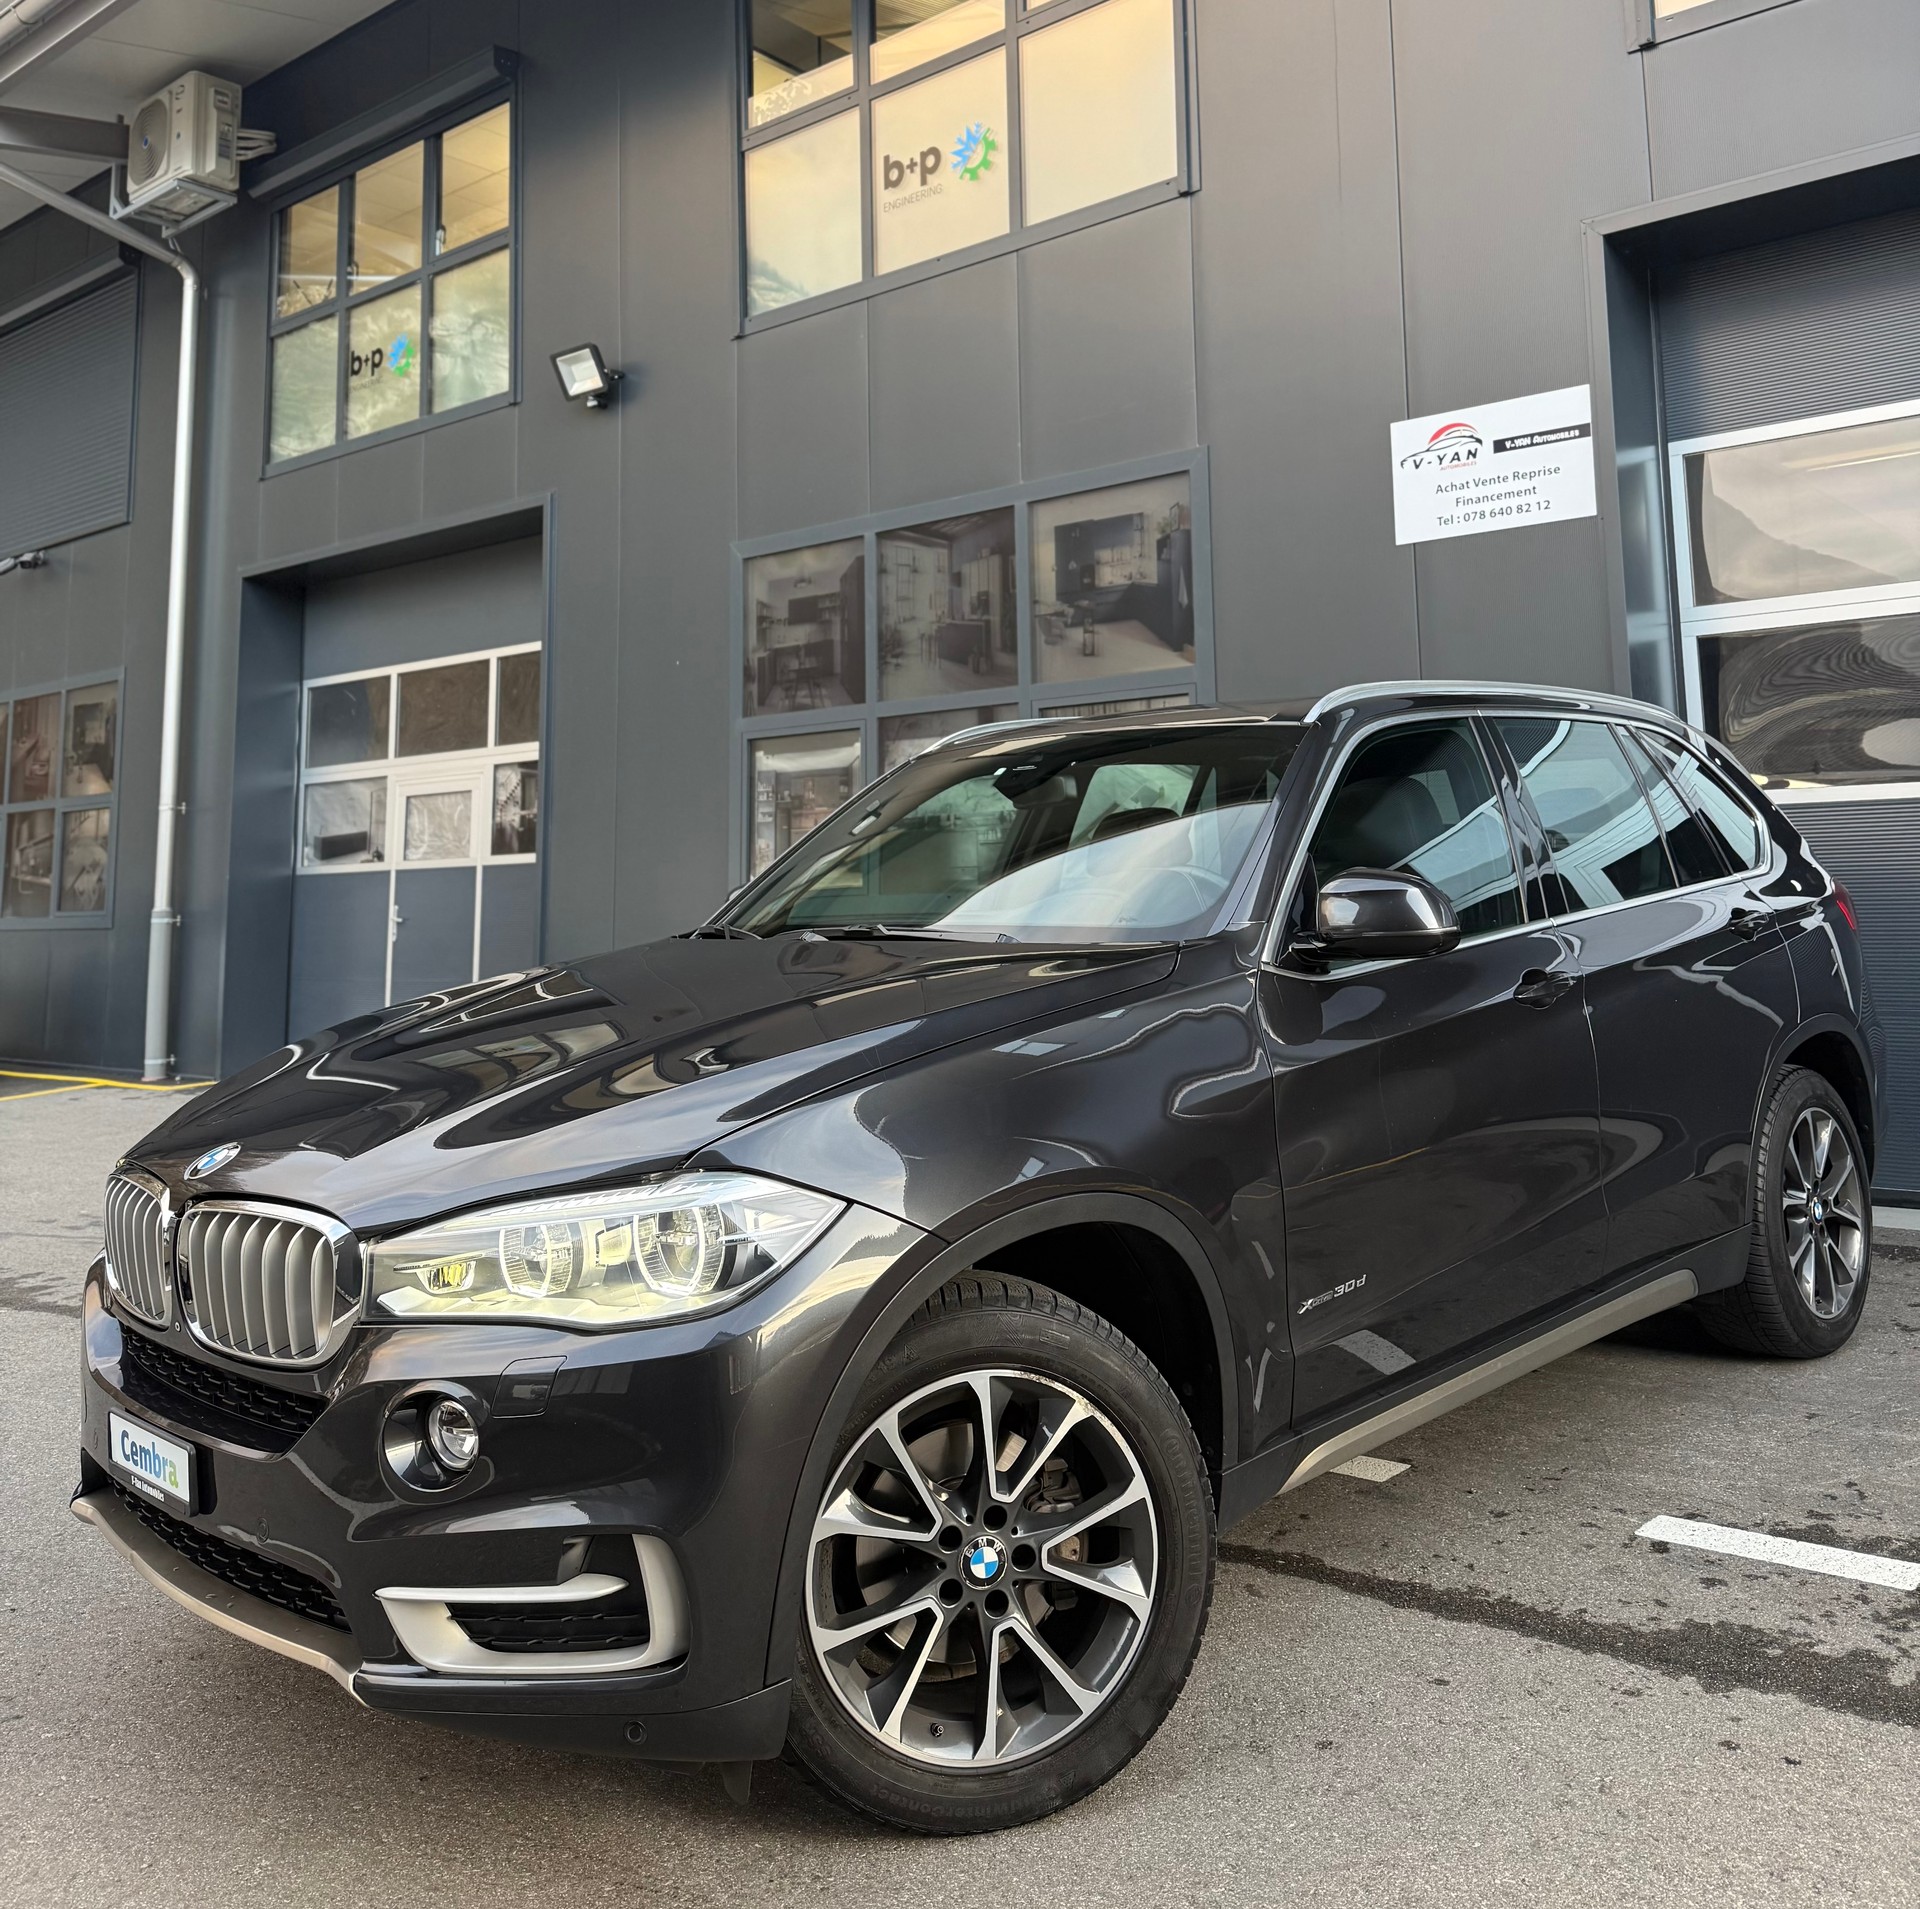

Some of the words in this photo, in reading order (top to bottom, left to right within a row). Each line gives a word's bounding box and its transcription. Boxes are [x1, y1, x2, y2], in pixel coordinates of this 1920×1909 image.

[883, 146, 942, 190] b+p
[883, 184, 943, 213] ENGINEERING
[350, 347, 383, 377] b+p
[1435, 480, 1470, 494] Achat
[1473, 474, 1509, 488] Vente
[1512, 465, 1561, 481] Reprise
[1455, 486, 1537, 507] Financement
[1463, 510, 1486, 522] 078
[1489, 505, 1513, 518] 640
[1516, 503, 1532, 514] 82
[1536, 499, 1551, 511] 12
[121, 1430, 178, 1489] Cembra
[965, 1537, 1002, 1558] BMW
